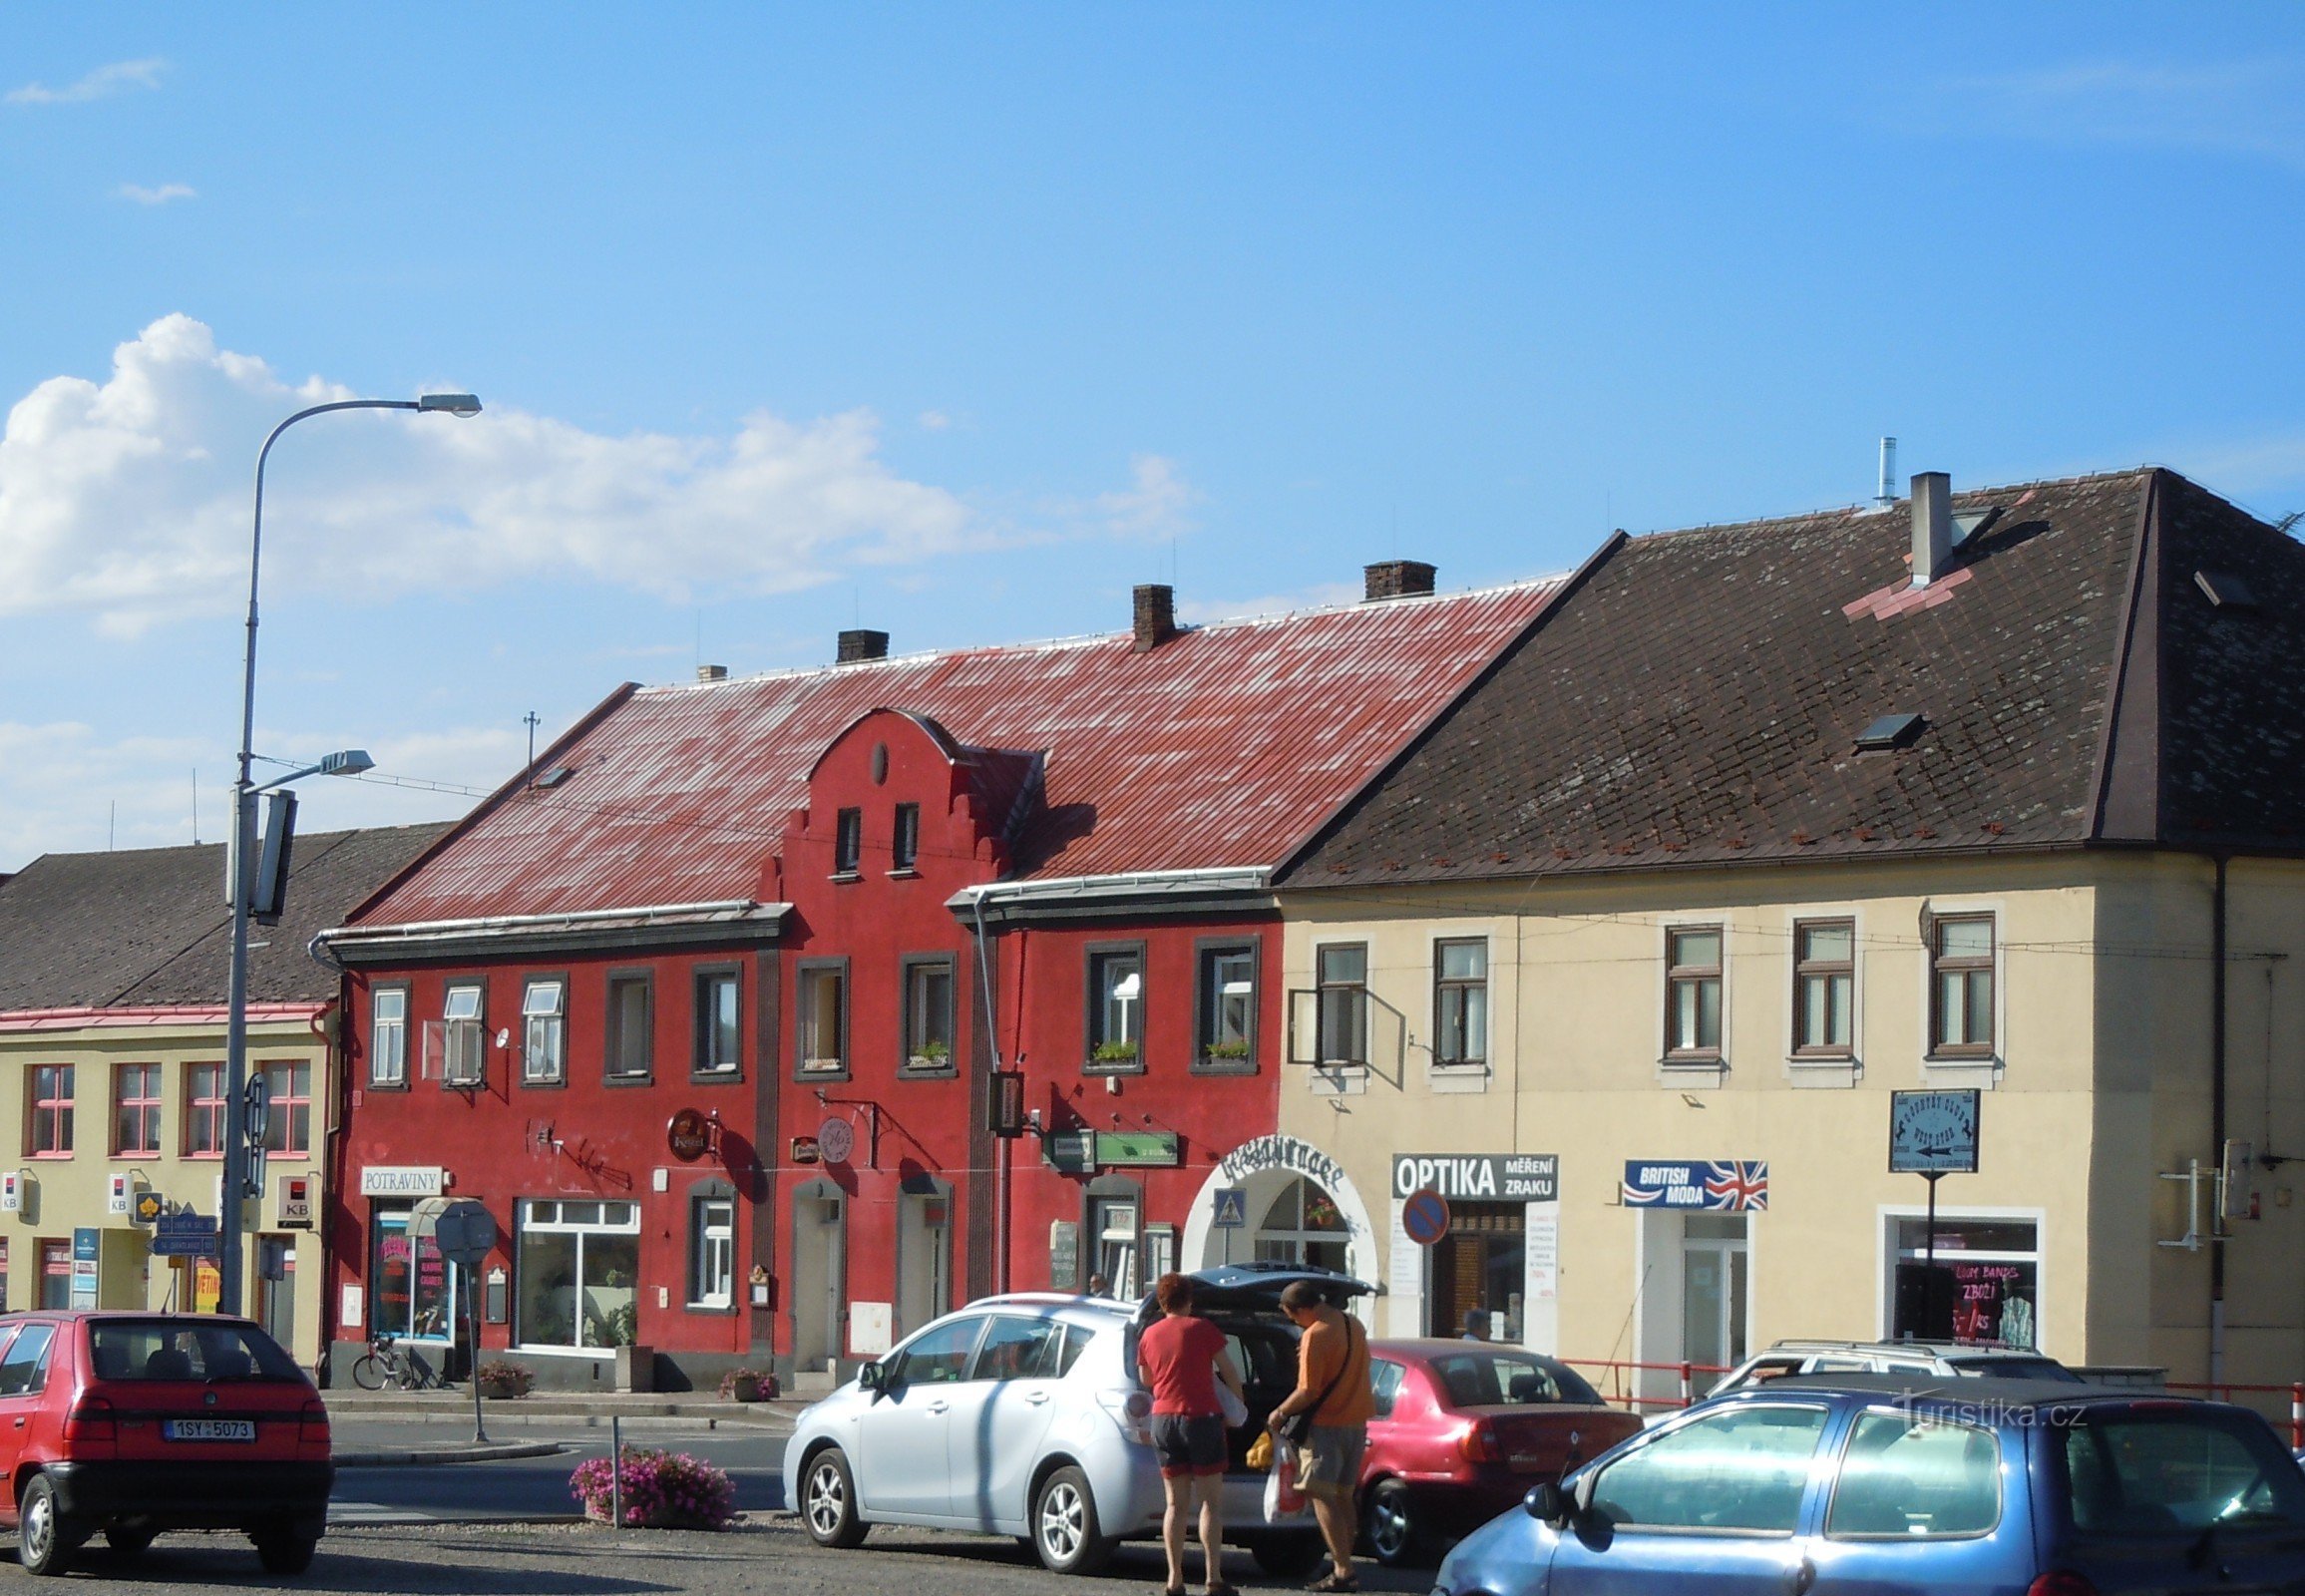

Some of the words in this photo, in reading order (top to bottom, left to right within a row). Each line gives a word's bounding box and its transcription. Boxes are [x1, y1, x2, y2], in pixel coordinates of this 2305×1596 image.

[1904, 1095, 1941, 1123] COUNTRY
[1944, 1097, 1966, 1121] CLUB
[1914, 1126, 1933, 1145] WEST
[1935, 1126, 1954, 1146] STAR
[1504, 1157, 1554, 1174] MĚŘENÍ
[365, 1172, 437, 1190] POTRAVINY
[1397, 1157, 1496, 1196] OPTIKA
[1639, 1166, 1691, 1185] BRITISH
[1504, 1179, 1553, 1196] ZRAKU
[1666, 1185, 1705, 1204] MODA
[3, 1198, 17, 1208] KB
[112, 1200, 127, 1210] KB
[286, 1204, 309, 1216] KB
[1983, 1266, 2019, 1278] BANDS
[177, 1421, 205, 1436] 1SY
[213, 1421, 248, 1437] 5073
